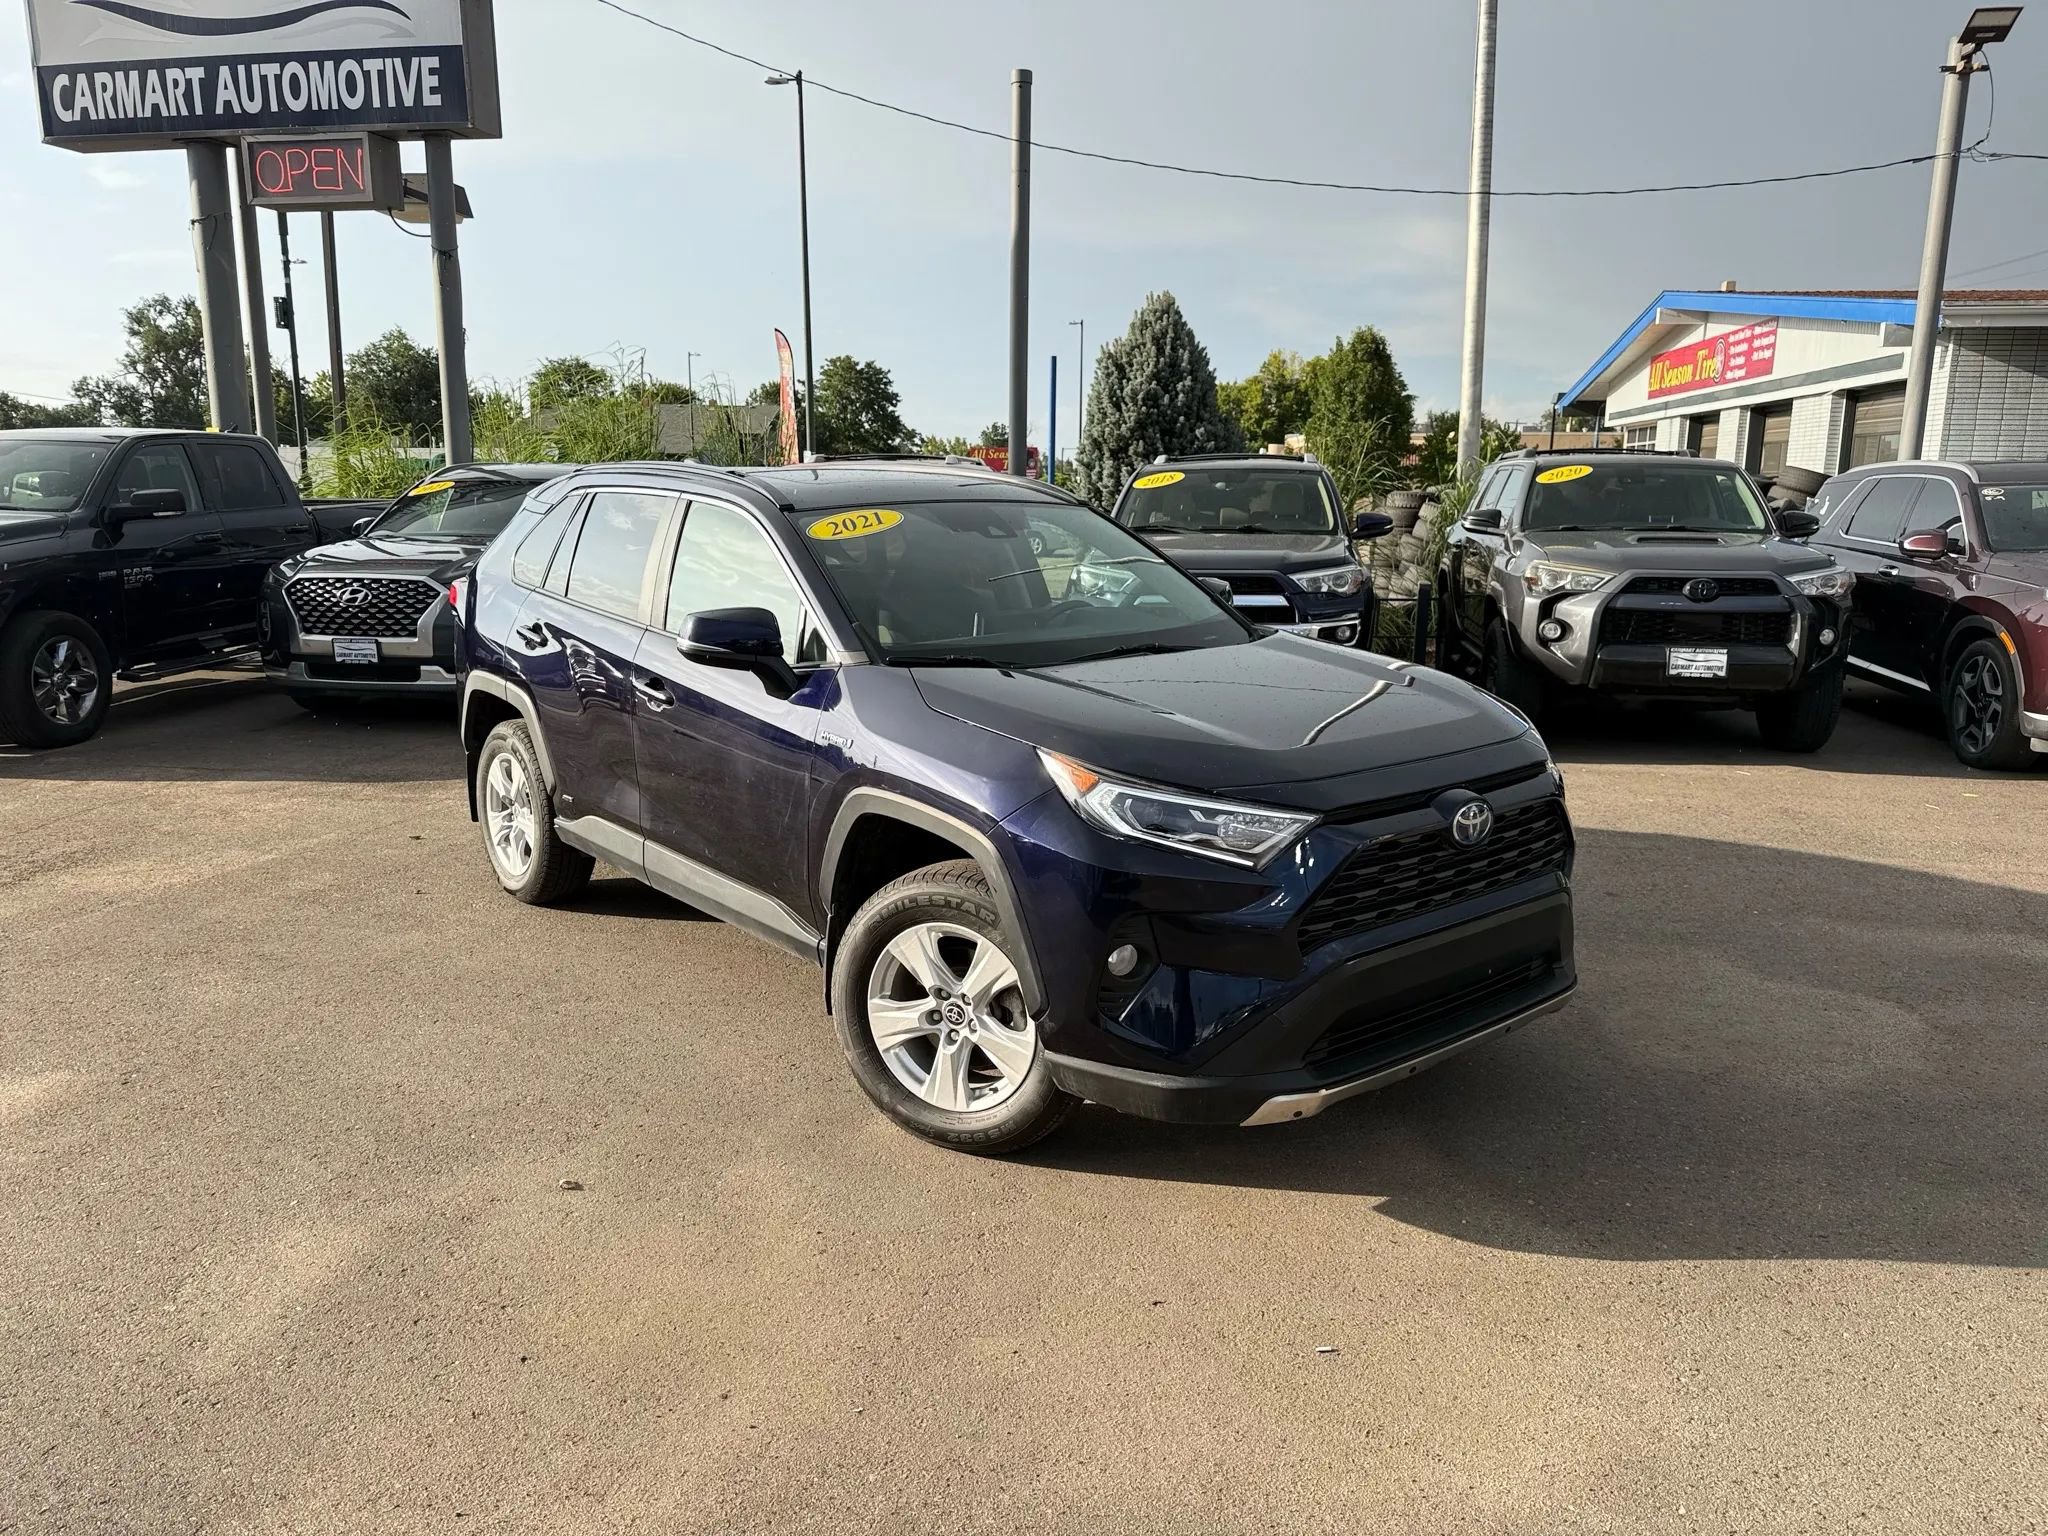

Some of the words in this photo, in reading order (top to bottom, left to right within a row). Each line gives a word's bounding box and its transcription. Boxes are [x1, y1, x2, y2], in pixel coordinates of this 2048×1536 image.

[53, 66, 206, 123] CARMART
[215, 56, 442, 115] AUTOMOTIVE
[255, 148, 364, 193] OPEN
[1648, 361, 1664, 391] All
[1660, 359, 1694, 389] Season
[973, 448, 987, 460] All
[987, 448, 1009, 460] Seas
[1142, 473, 1176, 486] 2018
[1546, 466, 1583, 481] 2020
[825, 511, 884, 537] 2021
[880, 894, 997, 926] MILESTAR
